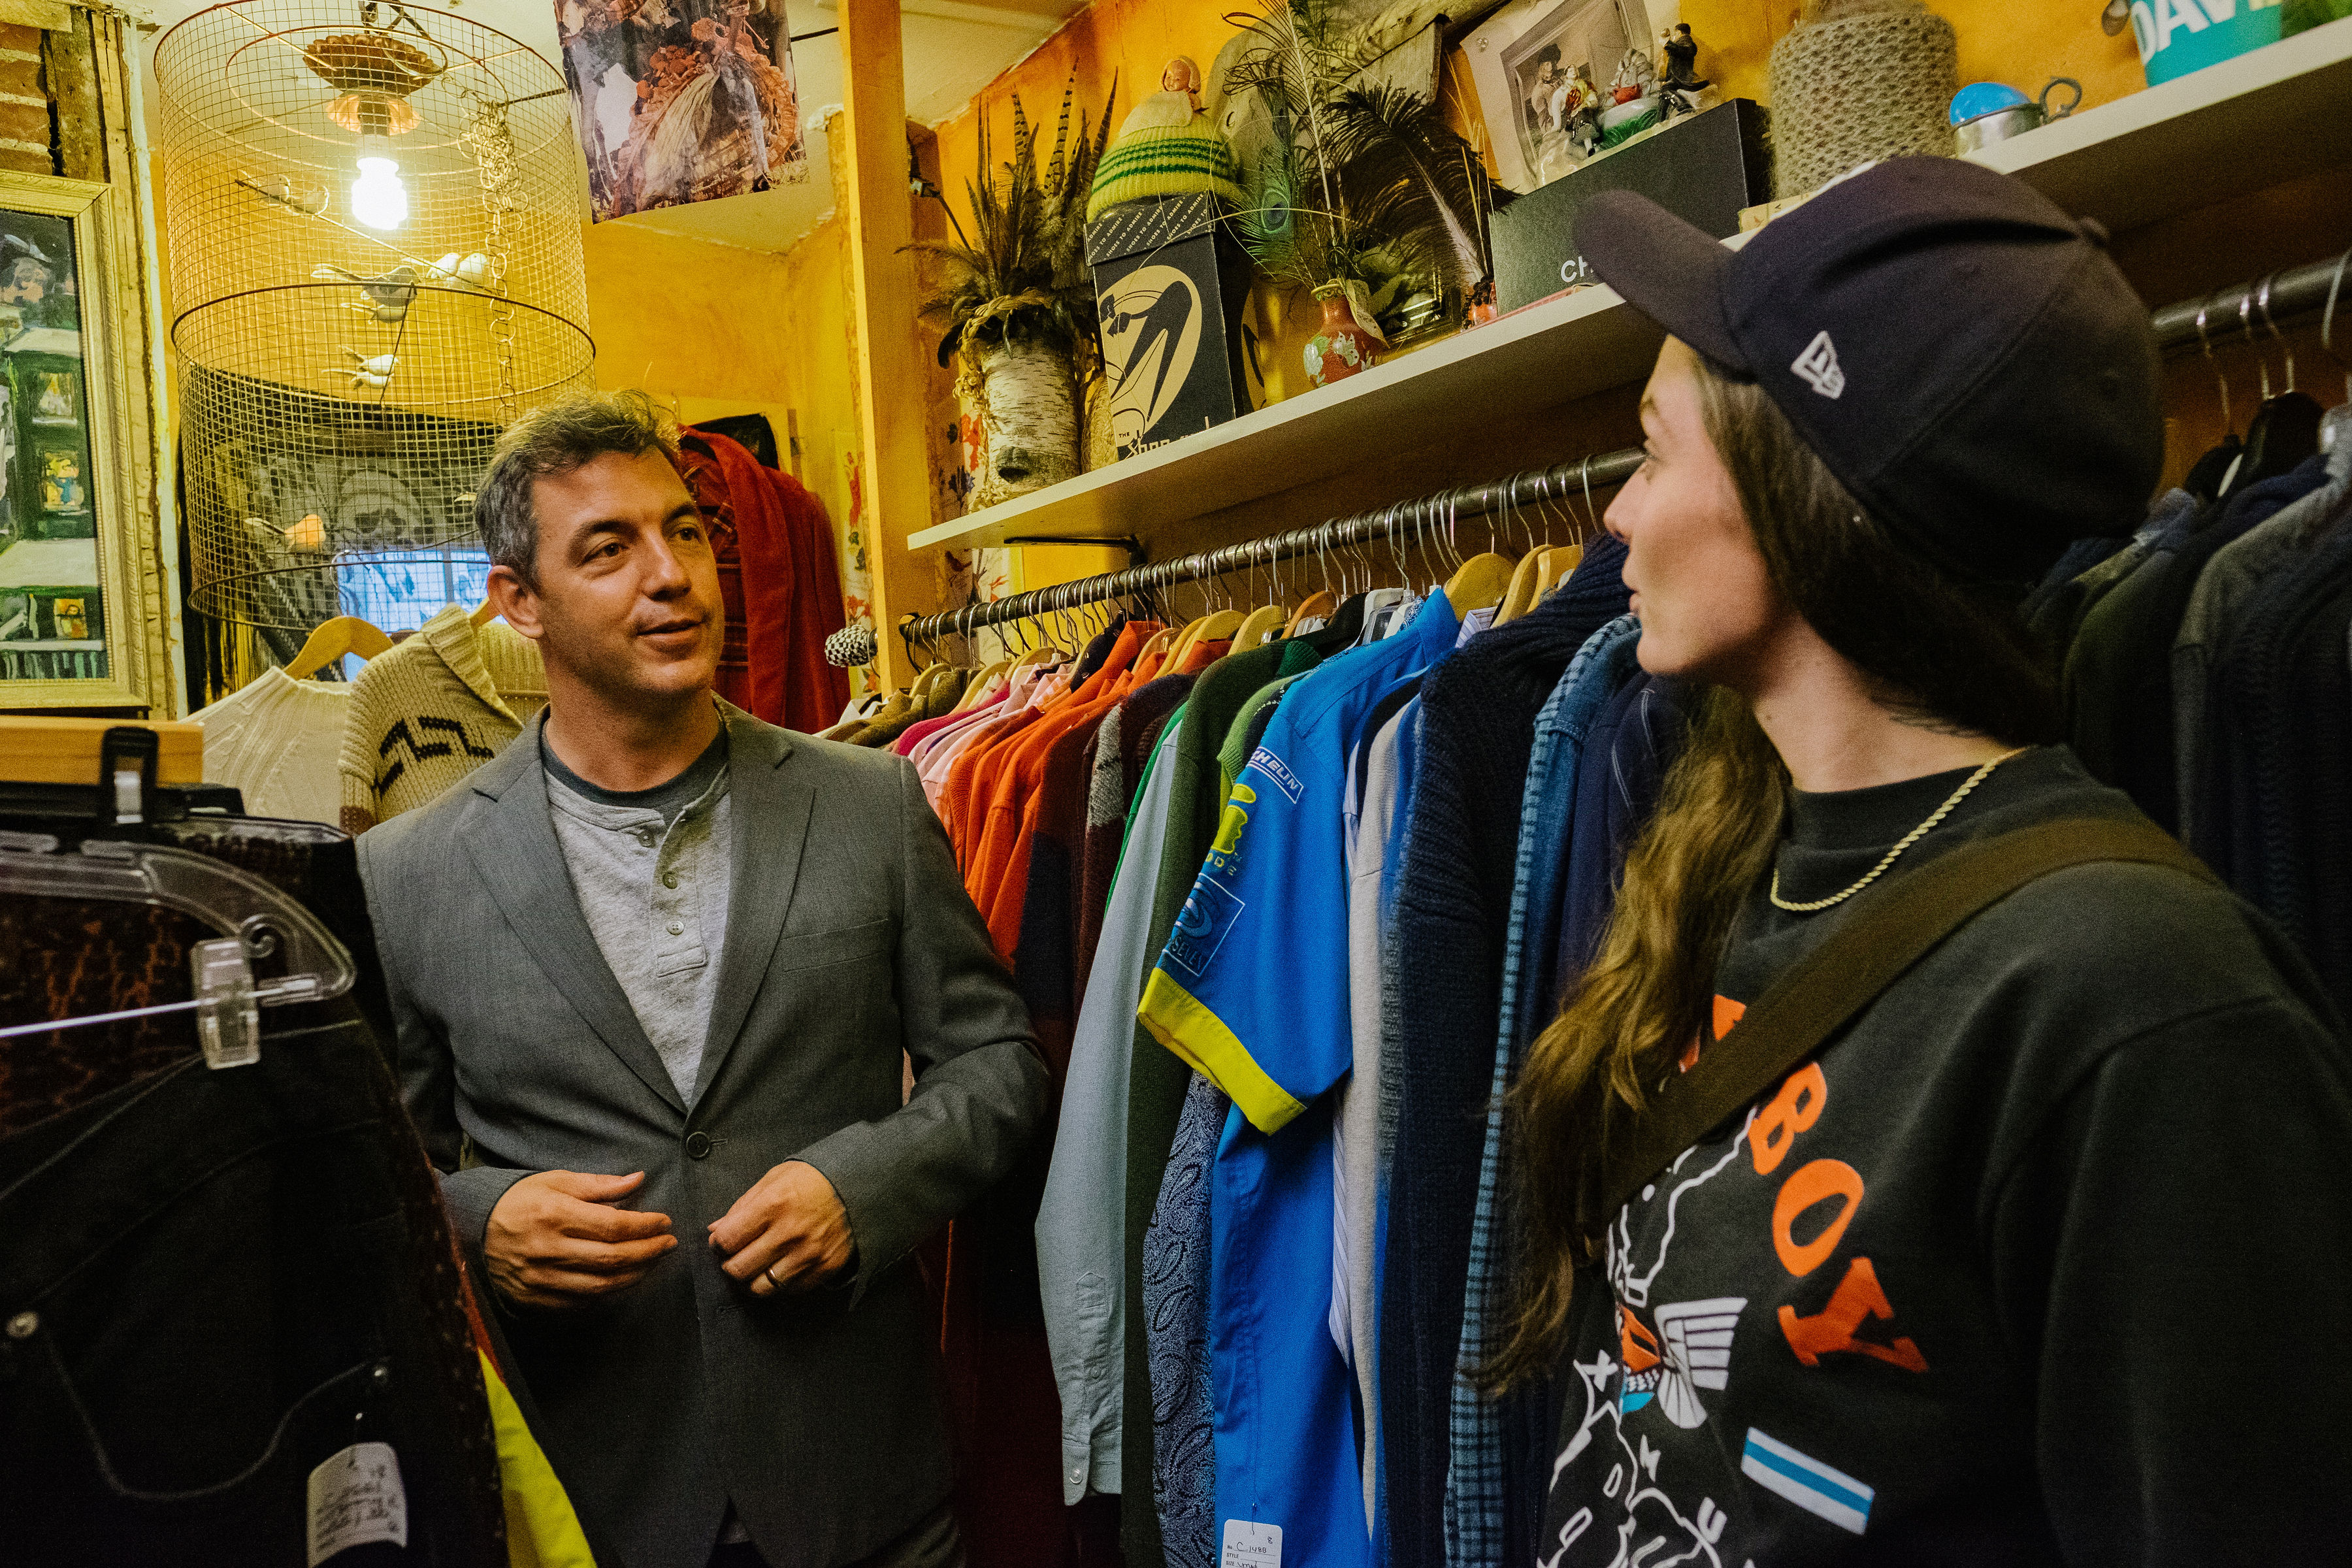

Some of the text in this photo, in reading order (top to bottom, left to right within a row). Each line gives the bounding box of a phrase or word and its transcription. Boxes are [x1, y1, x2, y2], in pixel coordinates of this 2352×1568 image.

[1087, 222, 1103, 242] ADMIRE
[1106, 240, 1120, 257] SHOES
[1126, 211, 1143, 232] ADMIRE
[1107, 217, 1123, 237] ADMIRE
[1126, 205, 1163, 252] SHOES TO ADMIRE
[1146, 200, 1184, 246] SHOES TO ADMIRE
[1166, 223, 1181, 240] SHOES
[1187, 193, 1204, 214] ADMIRE
